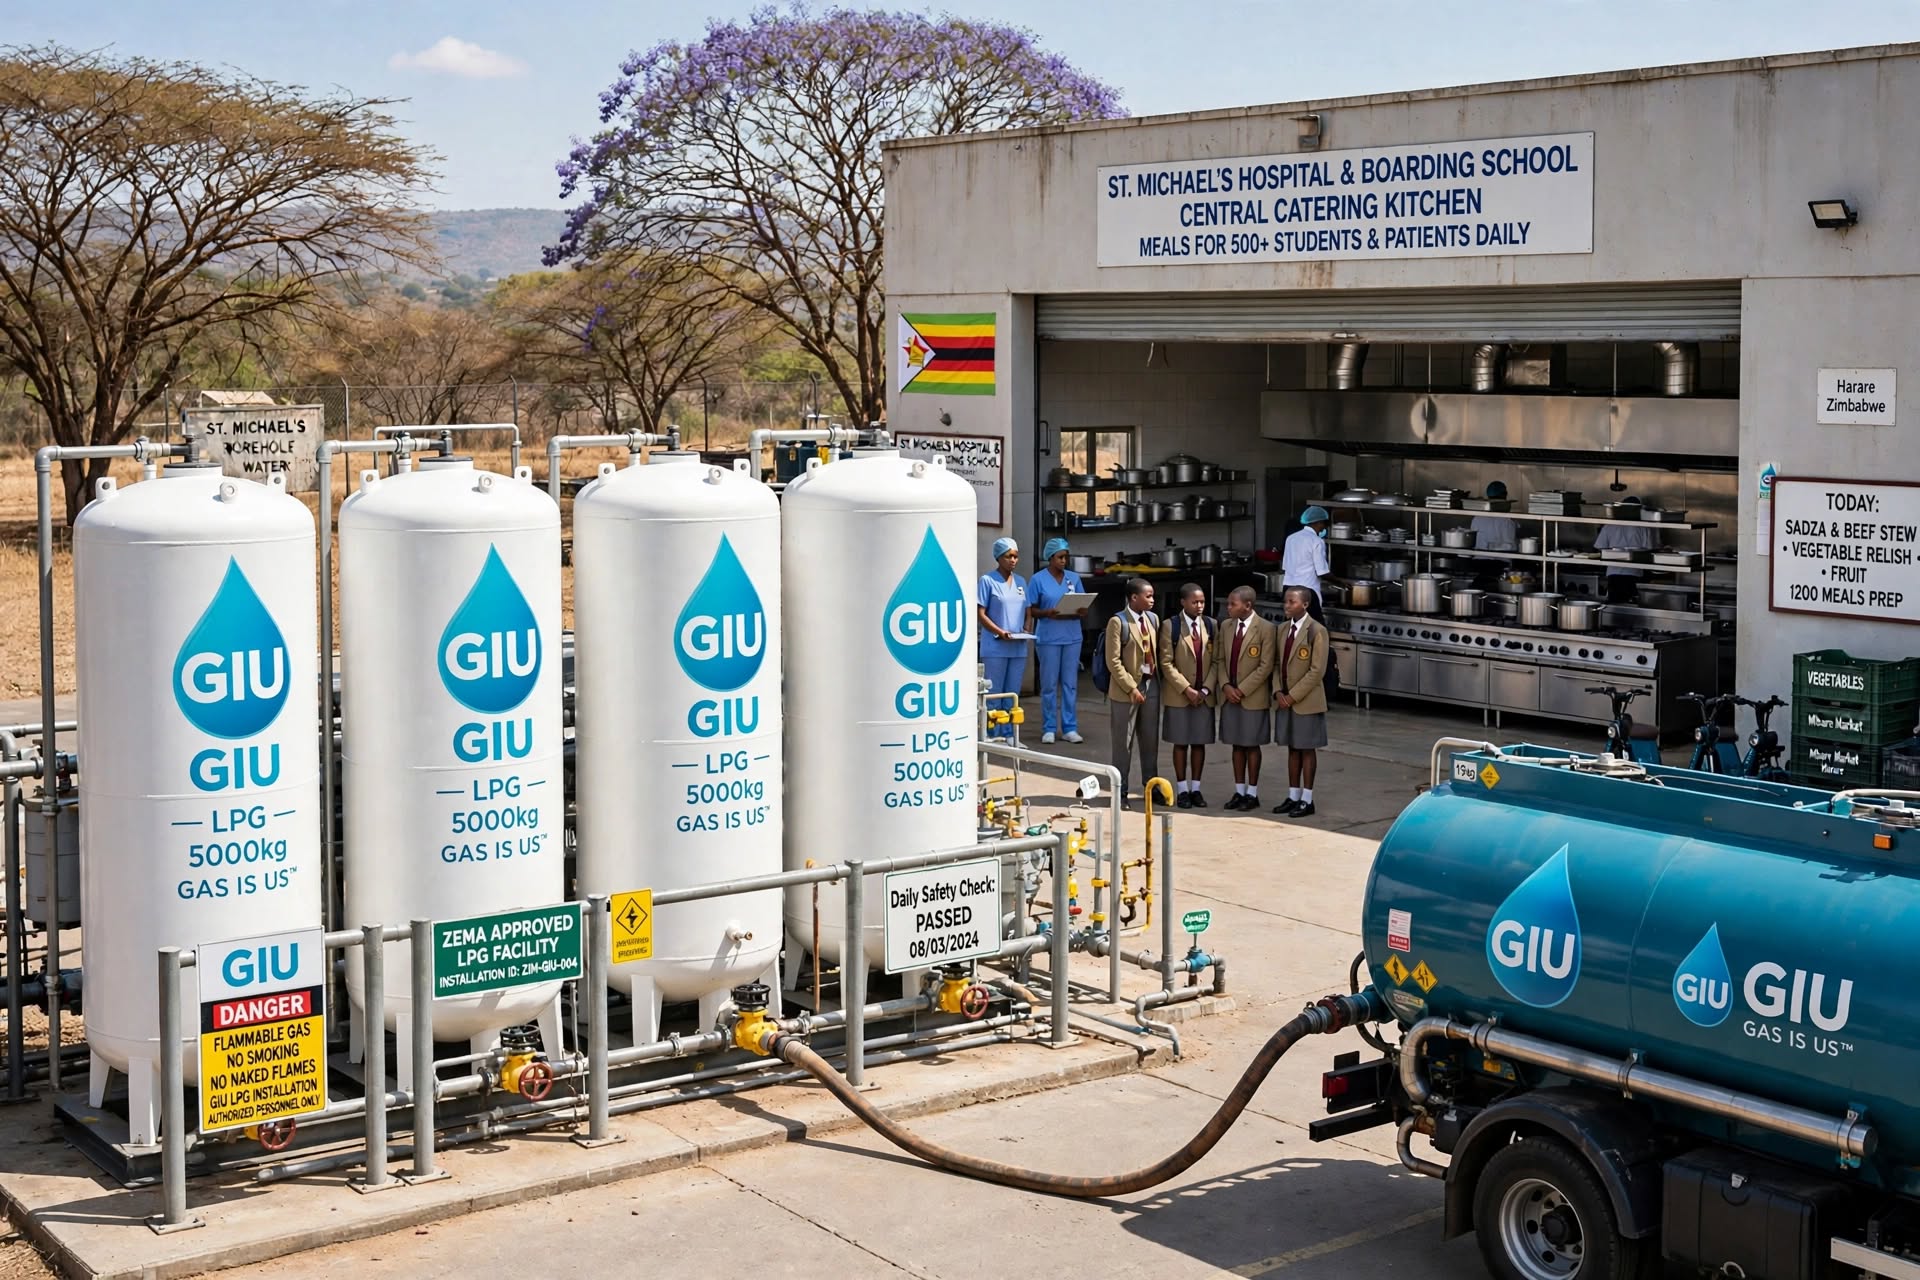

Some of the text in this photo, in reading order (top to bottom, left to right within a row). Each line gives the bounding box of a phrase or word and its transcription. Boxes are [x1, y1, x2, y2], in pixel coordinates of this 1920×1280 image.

[1108, 145, 1578, 198] ST. MICHAEL'S HOSPITAL & BOARDING SCHOOL
[1181, 188, 1482, 227] CENTRAL CATERING KITCHEN
[1140, 222, 1531, 257] MEALS FOR 500+ STUDENTS & PATIENTS DAILY
[1836, 379, 1876, 394] Harare
[1826, 398, 1886, 413] Zimbabwe
[206, 419, 306, 435] ST. MICHAEL'S
[1826, 493, 1879, 513] TODAY:
[1785, 519, 1917, 542] SADZA & BEEF STEW
[1792, 541, 1911, 565] VEGETABLE RELISH
[1831, 565, 1867, 583] FRUIT
[1790, 584, 1903, 608] 1200 MEALS PREP
[680, 611, 763, 661] GIU
[889, 600, 963, 646] GIU
[445, 628, 537, 681] GIU
[181, 647, 284, 704] GIU
[1807, 671, 1864, 690] VEGETABLES
[895, 679, 959, 719] GIU
[687, 696, 759, 738] GIU
[453, 718, 533, 763] GIU
[912, 731, 950, 754] LPG
[189, 743, 280, 792] GIU
[706, 750, 748, 775] LPG
[893, 758, 963, 782] 5000kg
[473, 776, 520, 801] LPG
[686, 779, 763, 805] 5000kg
[884, 790, 923, 808] GAS
[929, 788, 943, 805] IS
[212, 806, 266, 833] LPG
[451, 806, 539, 834] 5000kg
[676, 813, 719, 832] GAS
[725, 811, 740, 829] IS
[188, 838, 287, 868] 5000kg
[441, 843, 488, 864] GAS
[495, 840, 513, 859] IS
[177, 877, 229, 900] GAS
[237, 874, 257, 895] IS
[891, 875, 995, 909] Daily Safety Check:
[442, 914, 573, 948] ZEMA APPROVED
[916, 906, 972, 933] PASSED
[457, 937, 559, 967] LPG FACILITY
[909, 930, 979, 958] 08/03/2024
[1492, 920, 1575, 979] GIU
[222, 942, 299, 988] GIU
[440, 956, 578, 988] INSTALLATION ID: ZIM-GIU-004
[1676, 973, 1729, 1010] GIU
[1743, 961, 1854, 1032] GIU
[220, 994, 304, 1026] DANGER
[214, 1022, 311, 1052] FLAMMABLE GAS
[1743, 1020, 1782, 1044] GAS
[1789, 1030, 1806, 1049] IS
[227, 1042, 299, 1068] NO SMOKING
[211, 1059, 316, 1091] NO NAKED FLAMES
[210, 1078, 317, 1109] GIU LPG INSTALLATION
[208, 1094, 320, 1125] AUTHORIZED PERSONNEL ONLY
